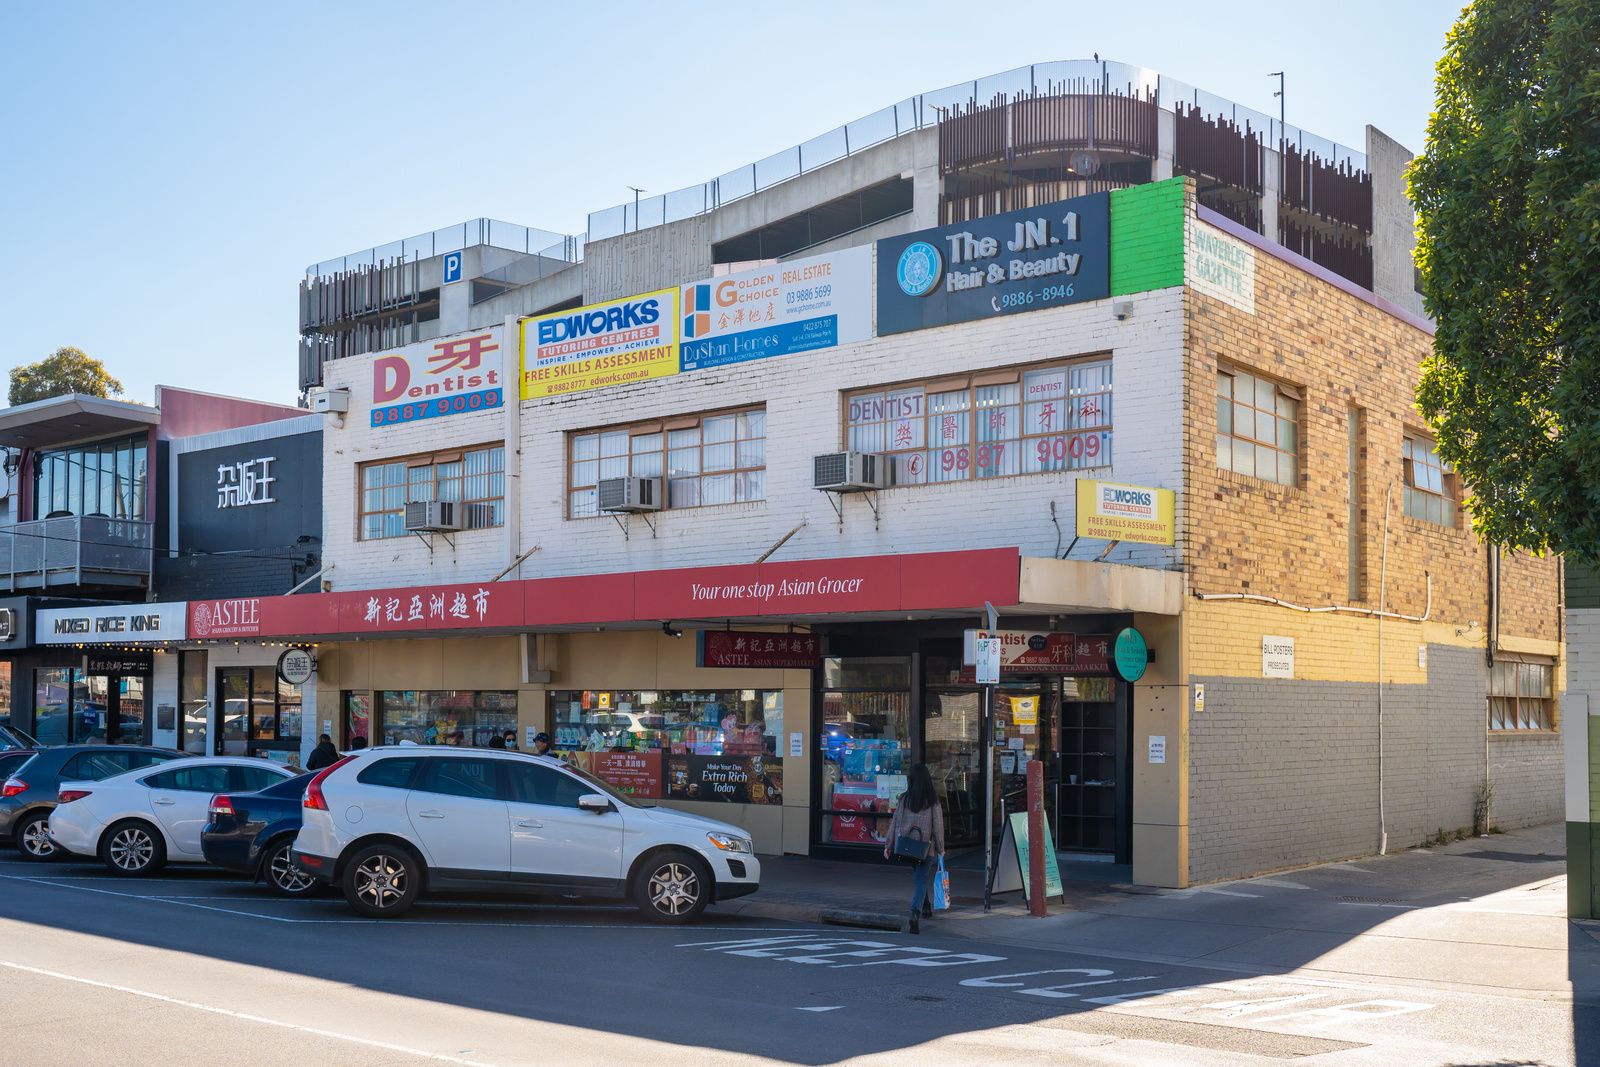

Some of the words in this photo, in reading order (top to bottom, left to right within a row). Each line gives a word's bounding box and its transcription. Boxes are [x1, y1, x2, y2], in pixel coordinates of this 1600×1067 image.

[946, 232, 998, 264] The
[447, 256, 459, 280] P
[782, 270, 802, 285] REAL
[803, 262, 832, 280] ESTATE
[946, 266, 986, 293] Hair
[986, 263, 1005, 284] &
[1008, 251, 1080, 281] Beauty
[738, 287, 779, 303] CHOICE
[786, 291, 796, 304] 03
[796, 287, 814, 302] 9886
[814, 284, 832, 299] 5699
[1002, 283, 1075, 308] 9886-8946
[538, 299, 660, 345] EDWORKS
[537, 355, 567, 366] INSPIRE
[576, 346, 614, 359] EMPOWER
[625, 338, 660, 350] ACHIEVE
[542, 336, 597, 356] TUTORING
[601, 327, 654, 344] CENTRES
[734, 334, 778, 353] Homes
[424, 334, 499, 375] 牙
[525, 367, 551, 383] FREE
[554, 360, 591, 378] SKILLS
[594, 345, 673, 371] ASSESSMENT
[373, 356, 499, 405] Dentist
[570, 378, 587, 389] 8777
[590, 369, 649, 386] edworks.com.au
[1030, 382, 1062, 394] DENTIST
[373, 402, 429, 426] 9887
[437, 391, 499, 416] 9009
[849, 394, 924, 421] DENTIST
[942, 444, 1005, 472] 9887
[1037, 434, 1100, 463] 9009
[1103, 487, 1152, 506] EDWORKS
[1088, 516, 1104, 526] FREE
[1105, 518, 1126, 528] SKILLS
[1127, 521, 1167, 531] ASSESSMENT
[1125, 532, 1167, 543] edworks.com.au
[691, 583, 721, 600] Your
[722, 585, 746, 599] one
[747, 581, 775, 601] stop
[778, 579, 815, 597] Asian
[817, 576, 863, 594] Grocer
[54, 617, 91, 634] MIXED
[95, 616, 126, 633] RICE
[130, 614, 161, 632] KING
[211, 599, 260, 626] ASTEE
[717, 654, 750, 666] ASTEE
[702, 770, 726, 782] Extra
[728, 771, 748, 783] Rich
[713, 782, 736, 795] Today
[674, 934, 1008, 968] KEEP
